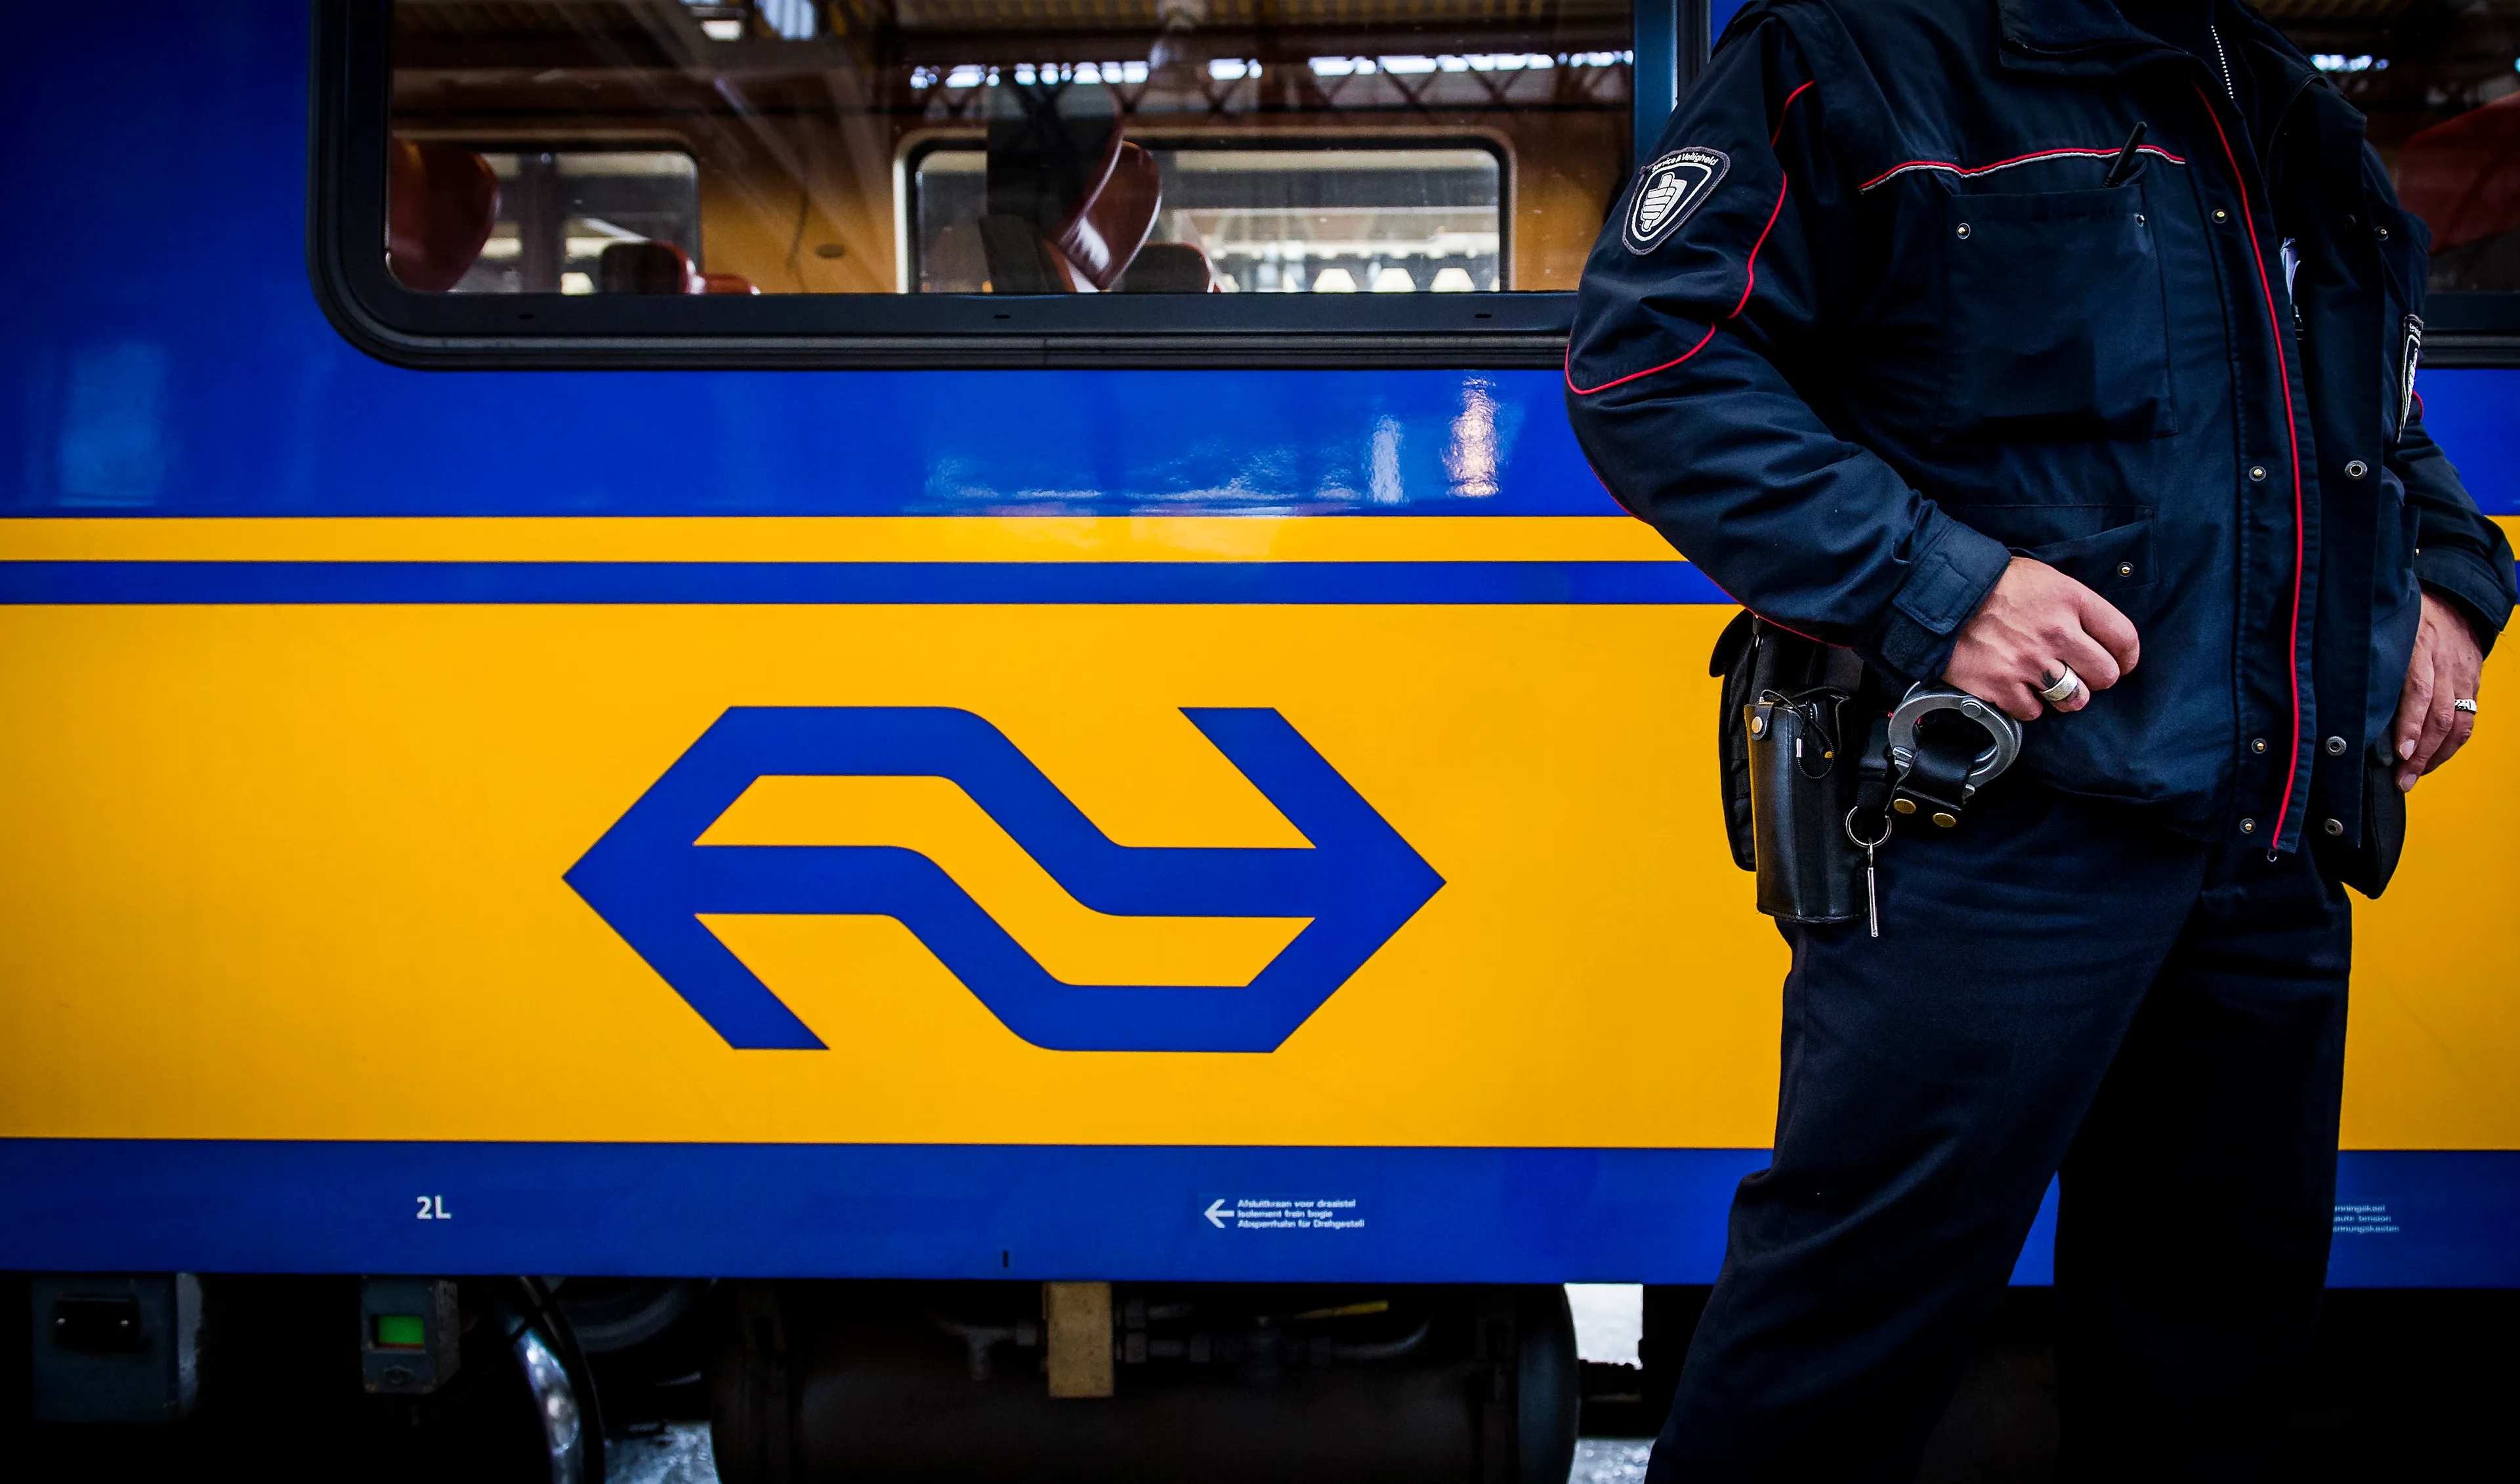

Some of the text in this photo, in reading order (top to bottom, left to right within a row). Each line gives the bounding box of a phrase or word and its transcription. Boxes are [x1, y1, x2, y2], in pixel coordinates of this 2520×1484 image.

[1652, 157, 1675, 173] Service
[1681, 152, 1719, 166] Veiligheid
[416, 1195, 452, 1219] 2L
